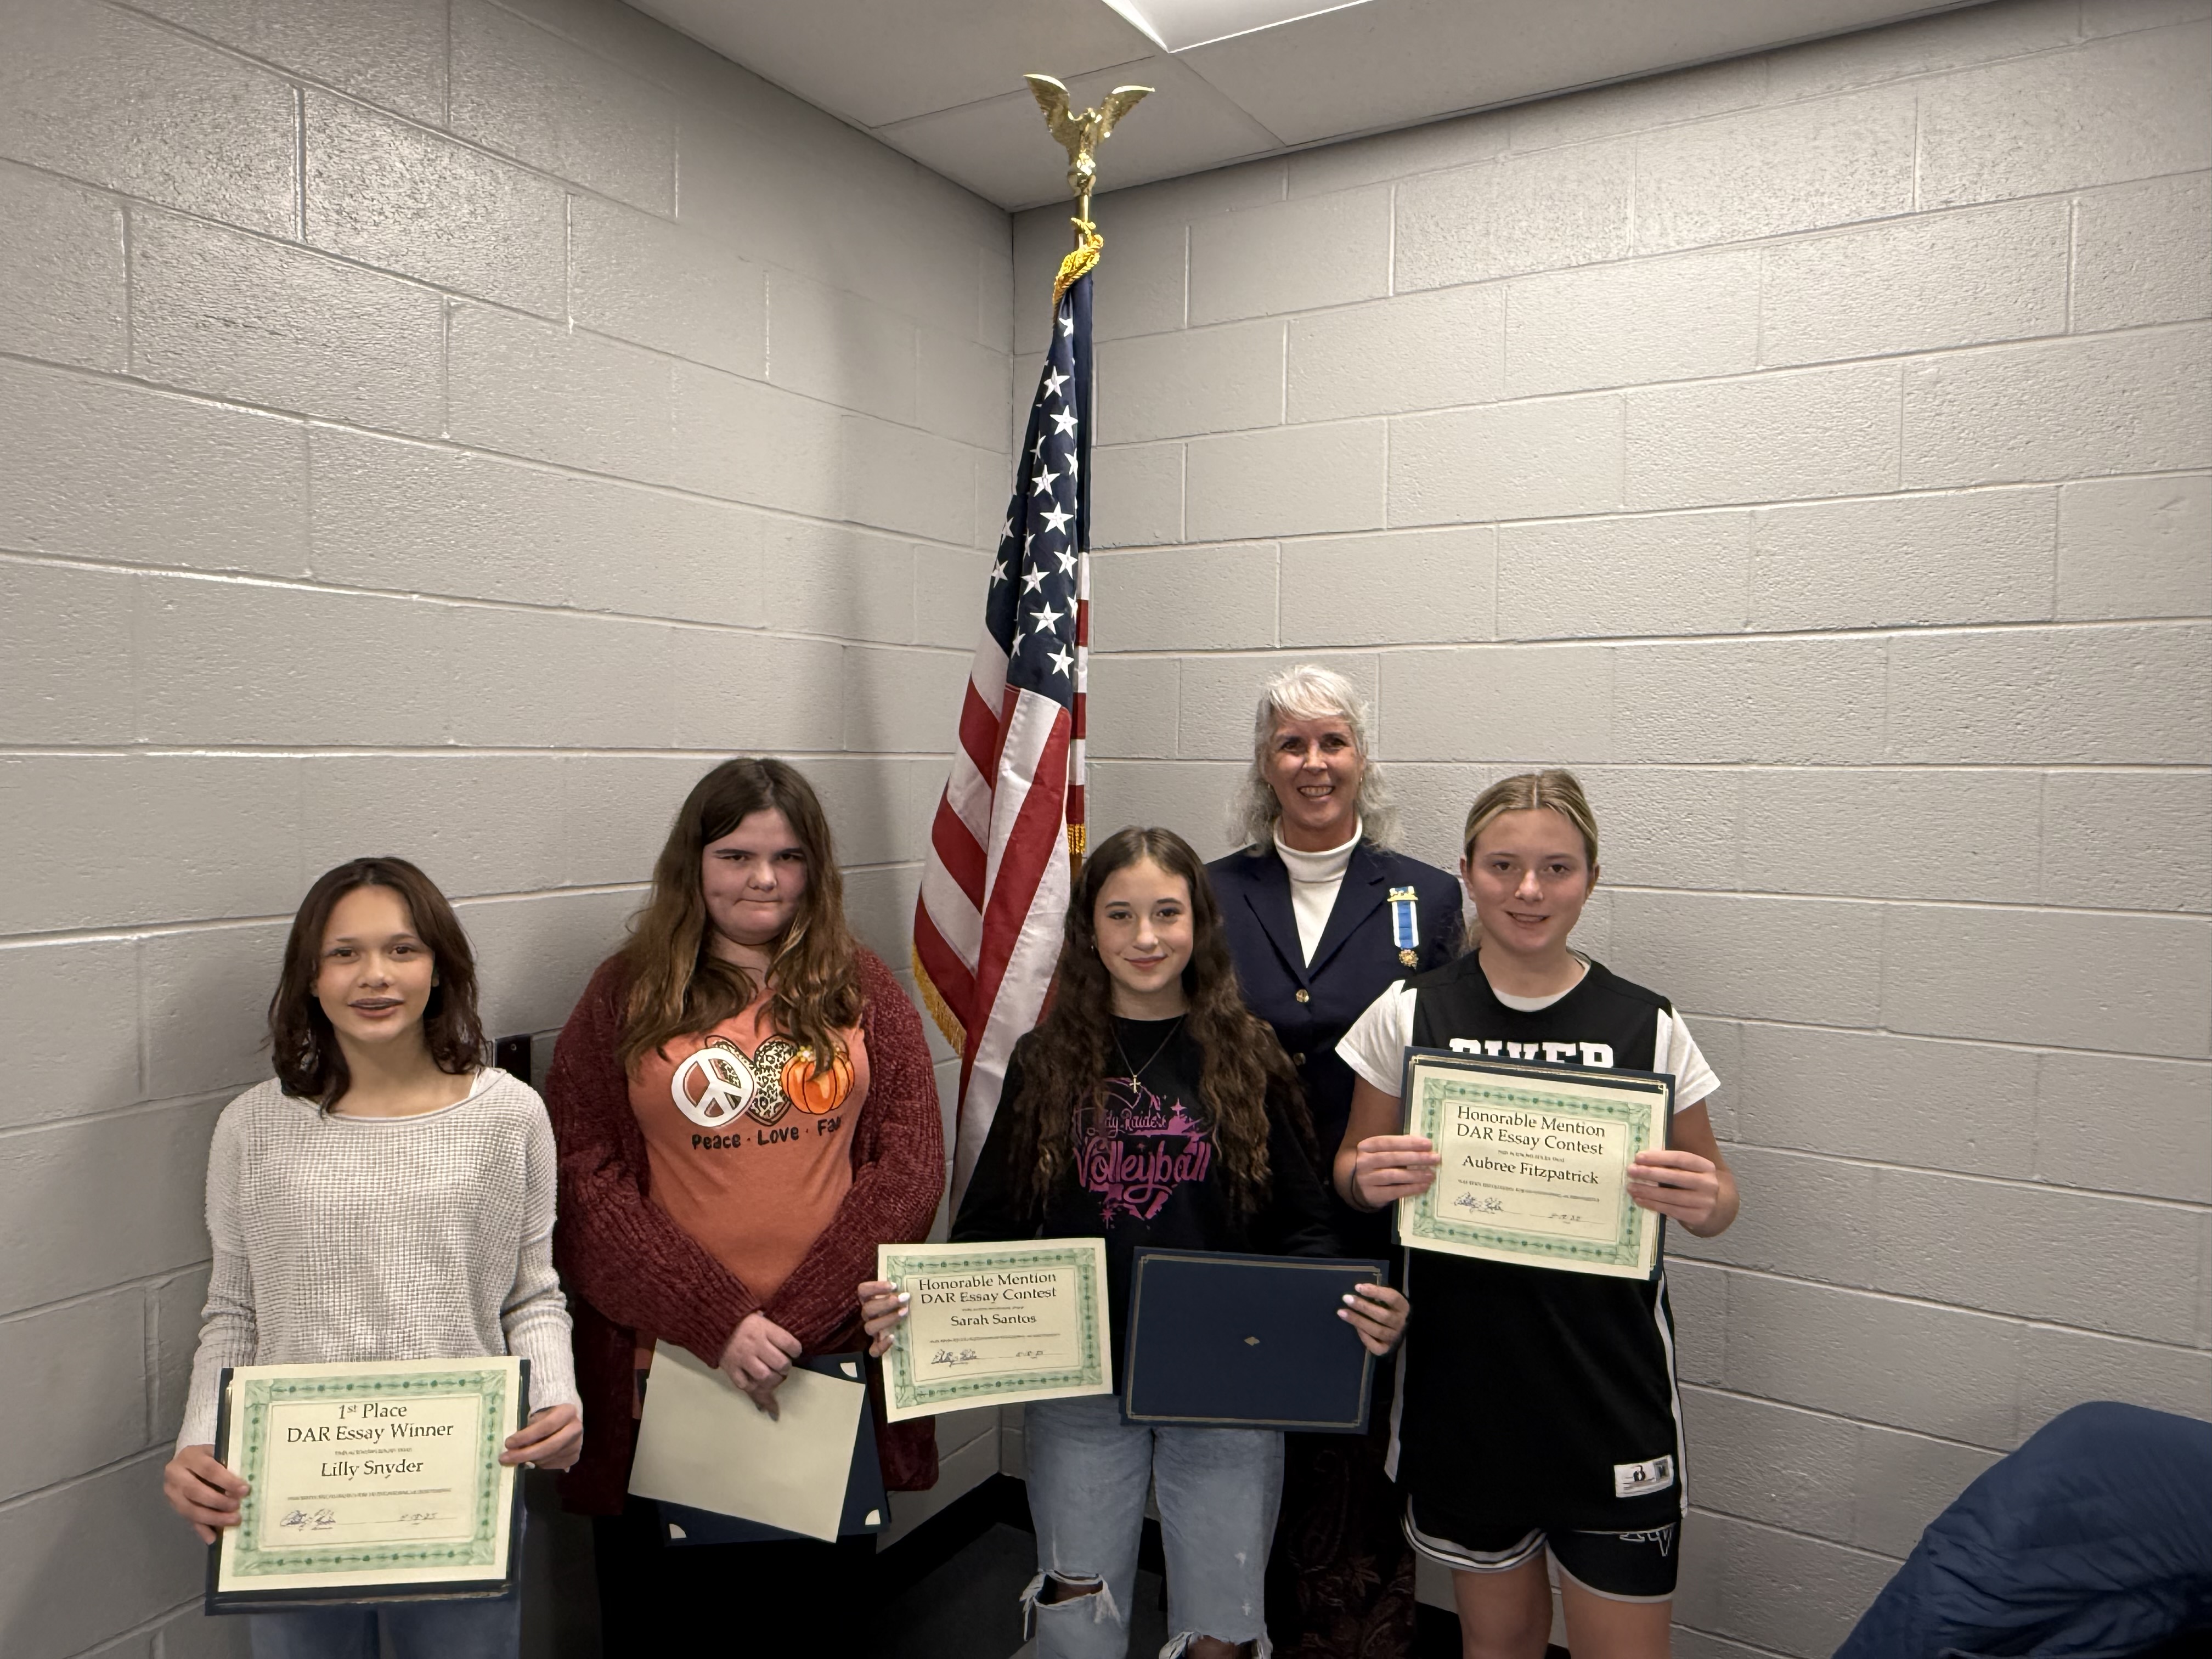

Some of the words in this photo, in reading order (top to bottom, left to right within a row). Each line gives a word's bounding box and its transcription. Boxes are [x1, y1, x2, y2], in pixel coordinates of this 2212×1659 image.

[1457, 1105, 1537, 1128] Honorable
[1541, 1117, 1605, 1137] Mention
[692, 1133, 741, 1150] Peace
[758, 1126, 799, 1146] Love
[1456, 1124, 1493, 1142] DAR
[1498, 1130, 1540, 1150] Essay
[1544, 1135, 1604, 1155] Contest
[1073, 1141, 1211, 1203] Volleyball
[1462, 1155, 1516, 1173] Aubree
[1519, 1162, 1599, 1184] Fitzpatrick
[919, 1276, 994, 1290] Honorable
[998, 1273, 1057, 1286] Mention
[921, 1293, 956, 1304] DAR
[960, 1292, 998, 1304] Essay
[1002, 1287, 1057, 1300] Contest
[951, 1314, 989, 1326] Sarah
[992, 1314, 1037, 1324] Santos
[338, 1403, 357, 1420] 1st
[362, 1403, 408, 1419] Place
[287, 1427, 330, 1442] DAR
[336, 1426, 384, 1444] Essay
[390, 1423, 454, 1438] Winner
[321, 1462, 359, 1481] Lilly
[363, 1459, 424, 1479] Snyder
